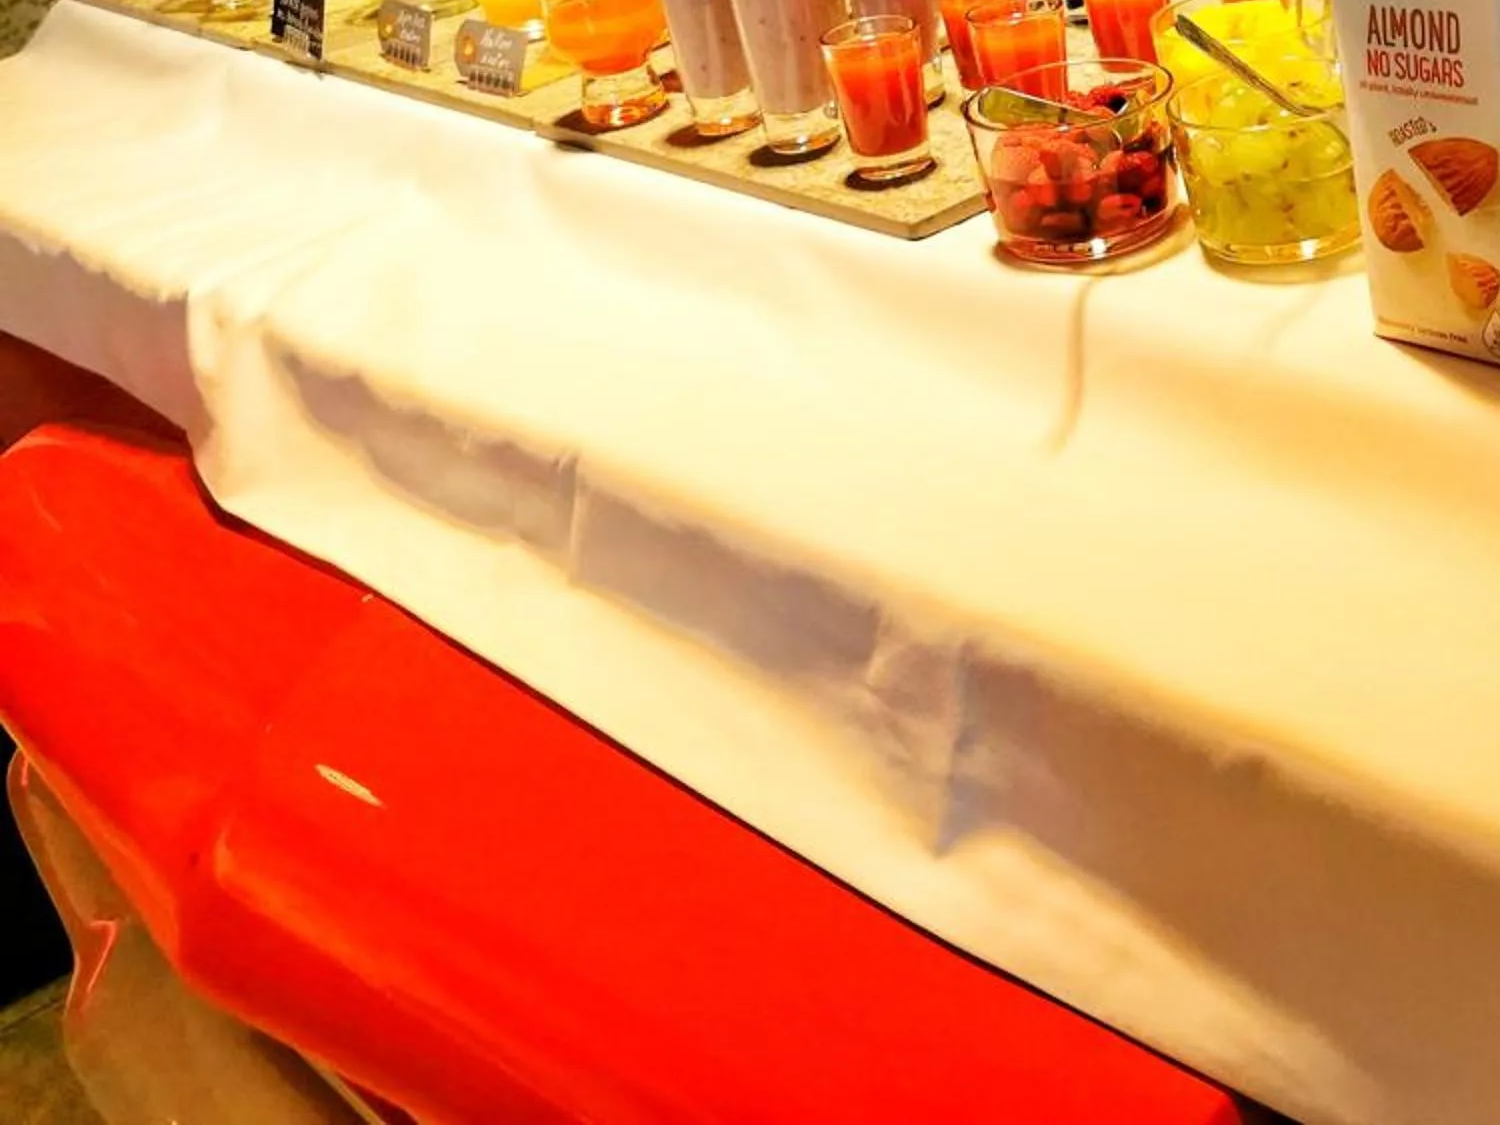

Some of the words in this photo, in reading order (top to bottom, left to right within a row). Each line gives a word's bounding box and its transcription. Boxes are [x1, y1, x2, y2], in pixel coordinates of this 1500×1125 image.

[1366, 4, 1461, 55] ALMOND
[1366, 49, 1393, 78] NO
[1395, 53, 1466, 88] SUGARS
